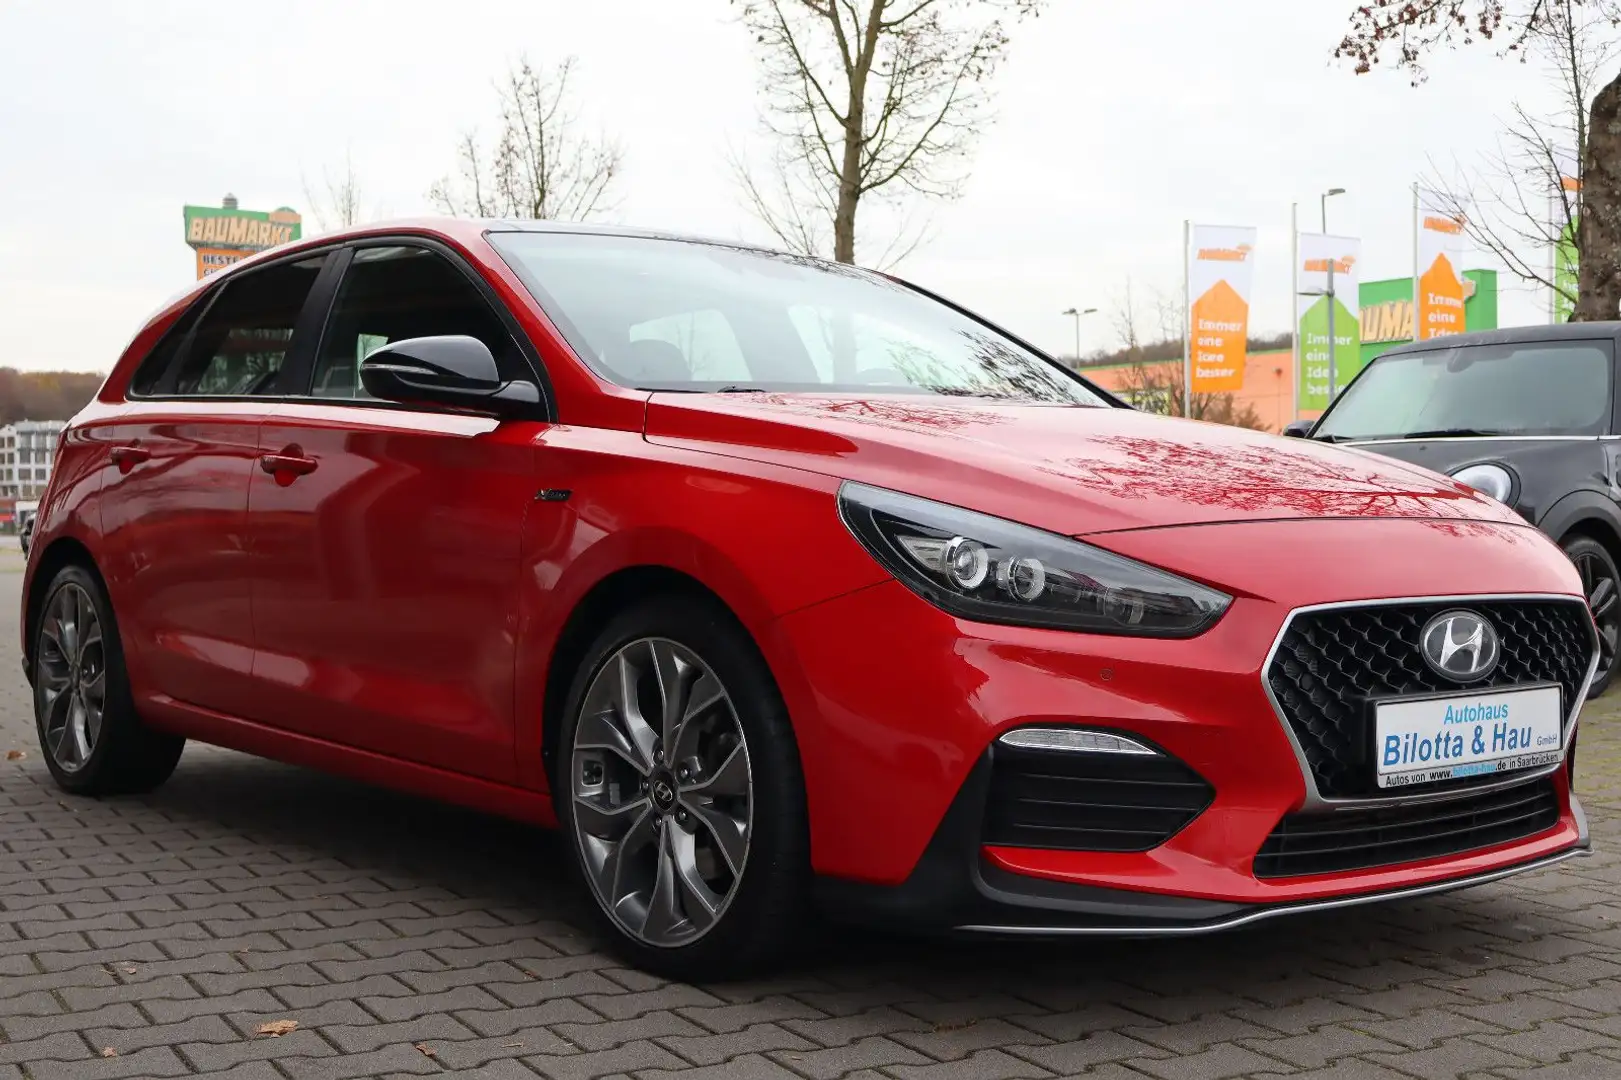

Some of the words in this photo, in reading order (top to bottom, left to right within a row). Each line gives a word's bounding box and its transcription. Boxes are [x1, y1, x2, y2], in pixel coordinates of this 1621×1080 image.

[188, 216, 293, 245] BAUMARKT
[1198, 319, 1243, 332] Immer
[1443, 702, 1509, 725] Autohaus
[1383, 730, 1464, 766] Bilotta
[1471, 725, 1486, 755] &
[1492, 723, 1532, 752] Hau
[1536, 735, 1558, 746] GmbH
[1385, 775, 1410, 786] Autos
[1411, 774, 1426, 782] von
[1509, 760, 1516, 768] in
[1517, 752, 1559, 767] Saarbrücken
